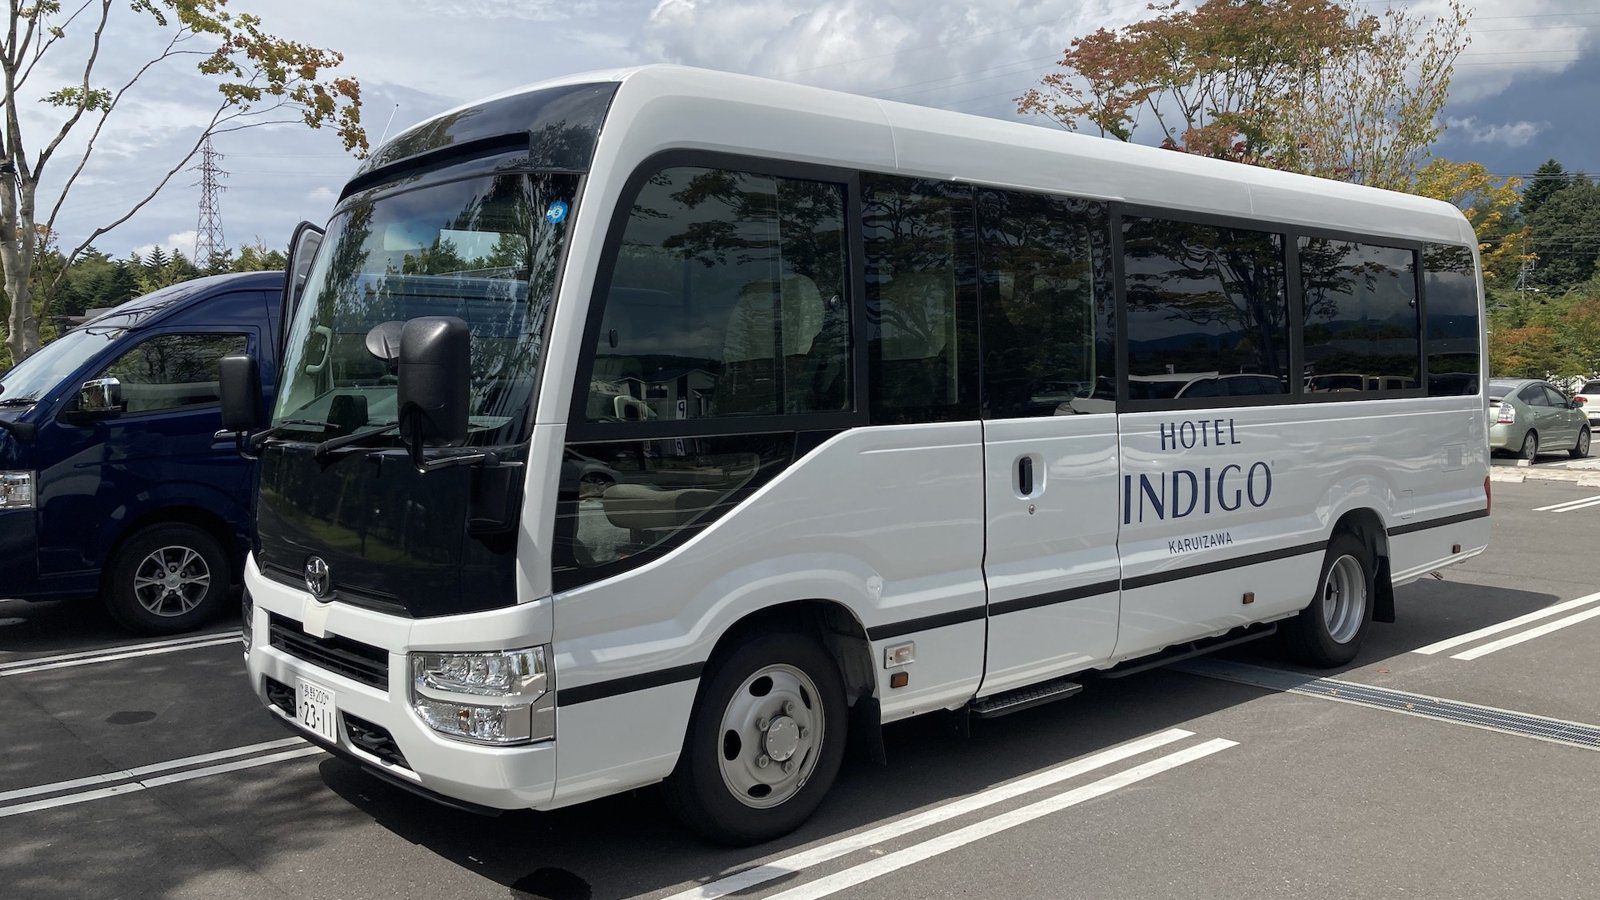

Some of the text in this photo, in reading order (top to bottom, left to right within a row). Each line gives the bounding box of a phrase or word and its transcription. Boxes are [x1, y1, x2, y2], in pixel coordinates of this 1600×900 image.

[1160, 418, 1241, 451] HOTEL
[1124, 461, 1272, 525] INDIGO
[1168, 532, 1233, 555] KARUIZAWA
